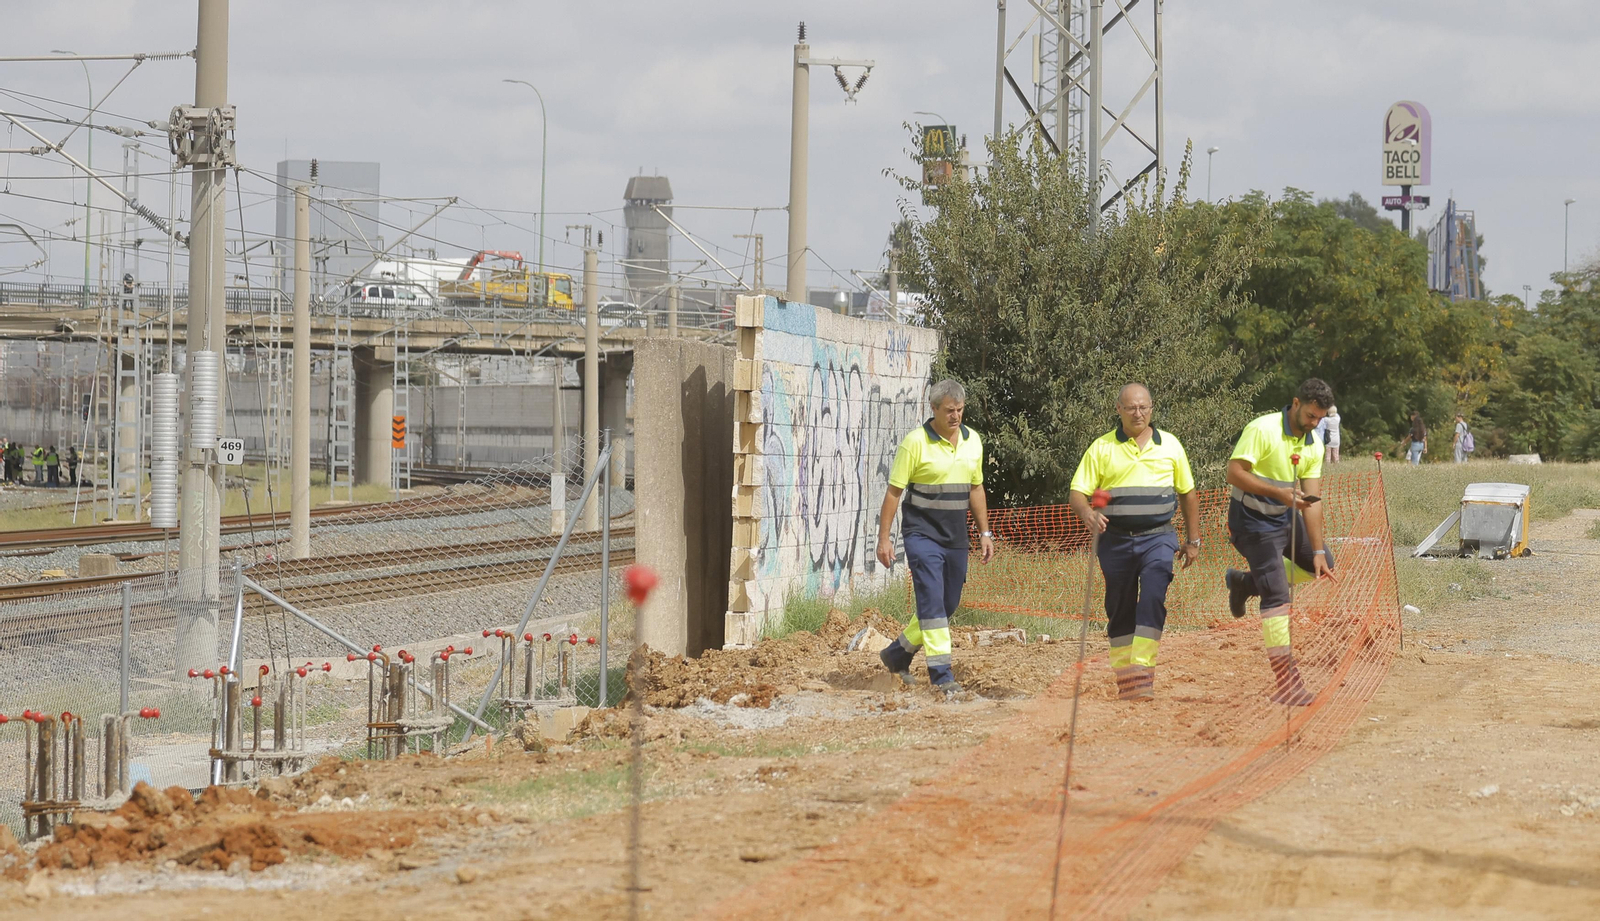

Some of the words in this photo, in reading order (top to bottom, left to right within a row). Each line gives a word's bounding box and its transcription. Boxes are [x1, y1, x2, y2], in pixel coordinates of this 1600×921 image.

[1384, 150, 1420, 164] TACO
[1386, 165, 1420, 179] BELL
[220, 441, 242, 451] 469
[227, 452, 234, 462] 0
